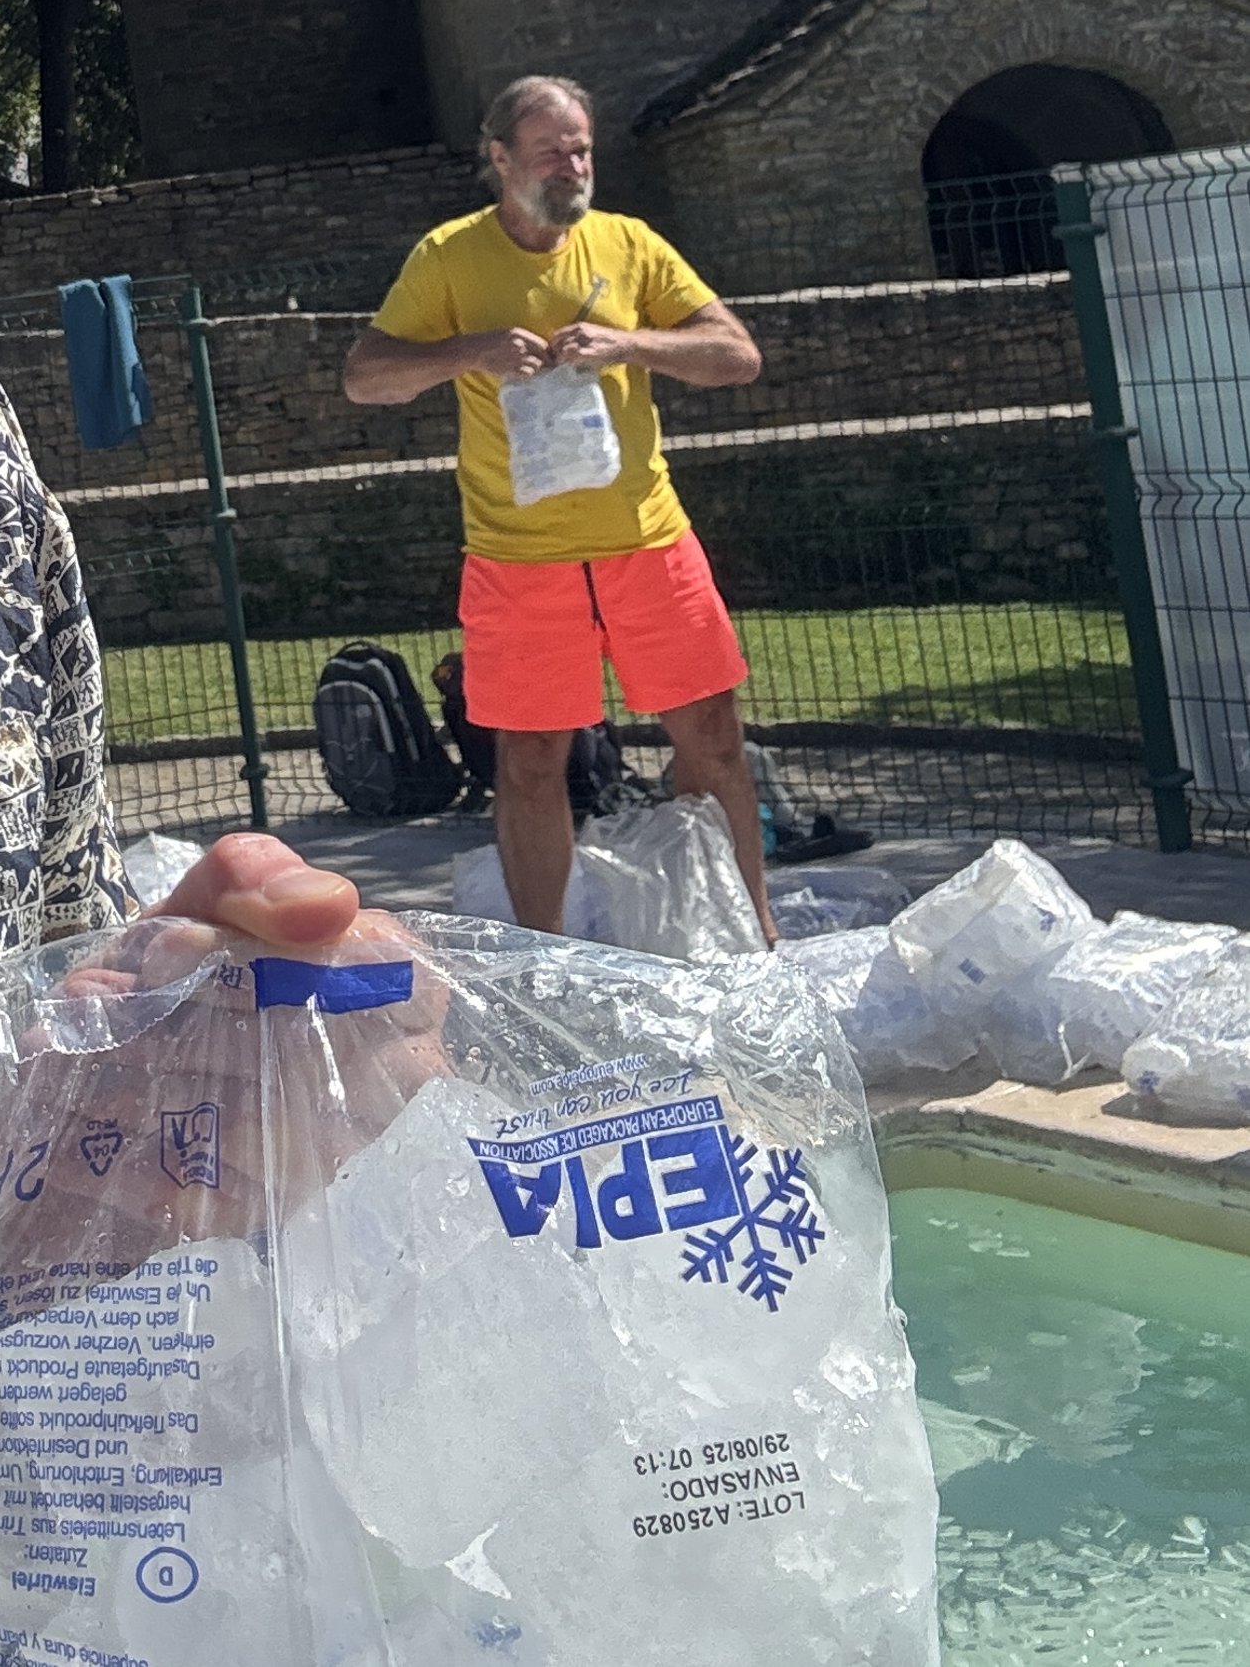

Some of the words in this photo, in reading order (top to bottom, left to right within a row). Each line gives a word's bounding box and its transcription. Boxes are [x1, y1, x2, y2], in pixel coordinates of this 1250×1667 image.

[601, 1072, 642, 1105] you
[648, 1068, 694, 1096] Ice
[554, 1094, 591, 1117] can
[640, 1099, 718, 1130] EUROPEAN
[560, 1130, 576, 1150] ICE
[578, 1116, 639, 1142] PACKAGED
[479, 1133, 559, 1158] ASSOCIATION
[478, 1125, 740, 1249] EPIA
[135, 1262, 162, 1281] auf
[60, 1286, 81, 1300] zu
[85, 1284, 161, 1306] Eiswürfel
[58, 1382, 127, 1406] gelagert
[39, 1408, 165, 1434] Tiefkühlprodukt
[168, 1412, 198, 1433] Das
[95, 1440, 128, 1459] und
[702, 1433, 790, 1465] 29/08/25
[26, 1460, 124, 1487] Entchlorung,
[634, 1448, 692, 1476] 07:13
[131, 1465, 222, 1487] Entkalkung,
[661, 1462, 800, 1502] ENVASADO:
[4, 1490, 26, 1508] mit
[31, 1491, 105, 1514] behandelt
[110, 1490, 190, 1515] hergestellt
[737, 1491, 805, 1521] LOTE:
[31, 1518, 57, 1535] aus
[61, 1520, 185, 1543] Lebensmitteleis
[633, 1503, 730, 1538] A250829
[24, 1544, 88, 1567] Zutaten:
[11, 1571, 96, 1598] Eiswürfel
[158, 1566, 174, 1586] D
[31, 1632, 40, 1651] y
[43, 1638, 76, 1661] dura
